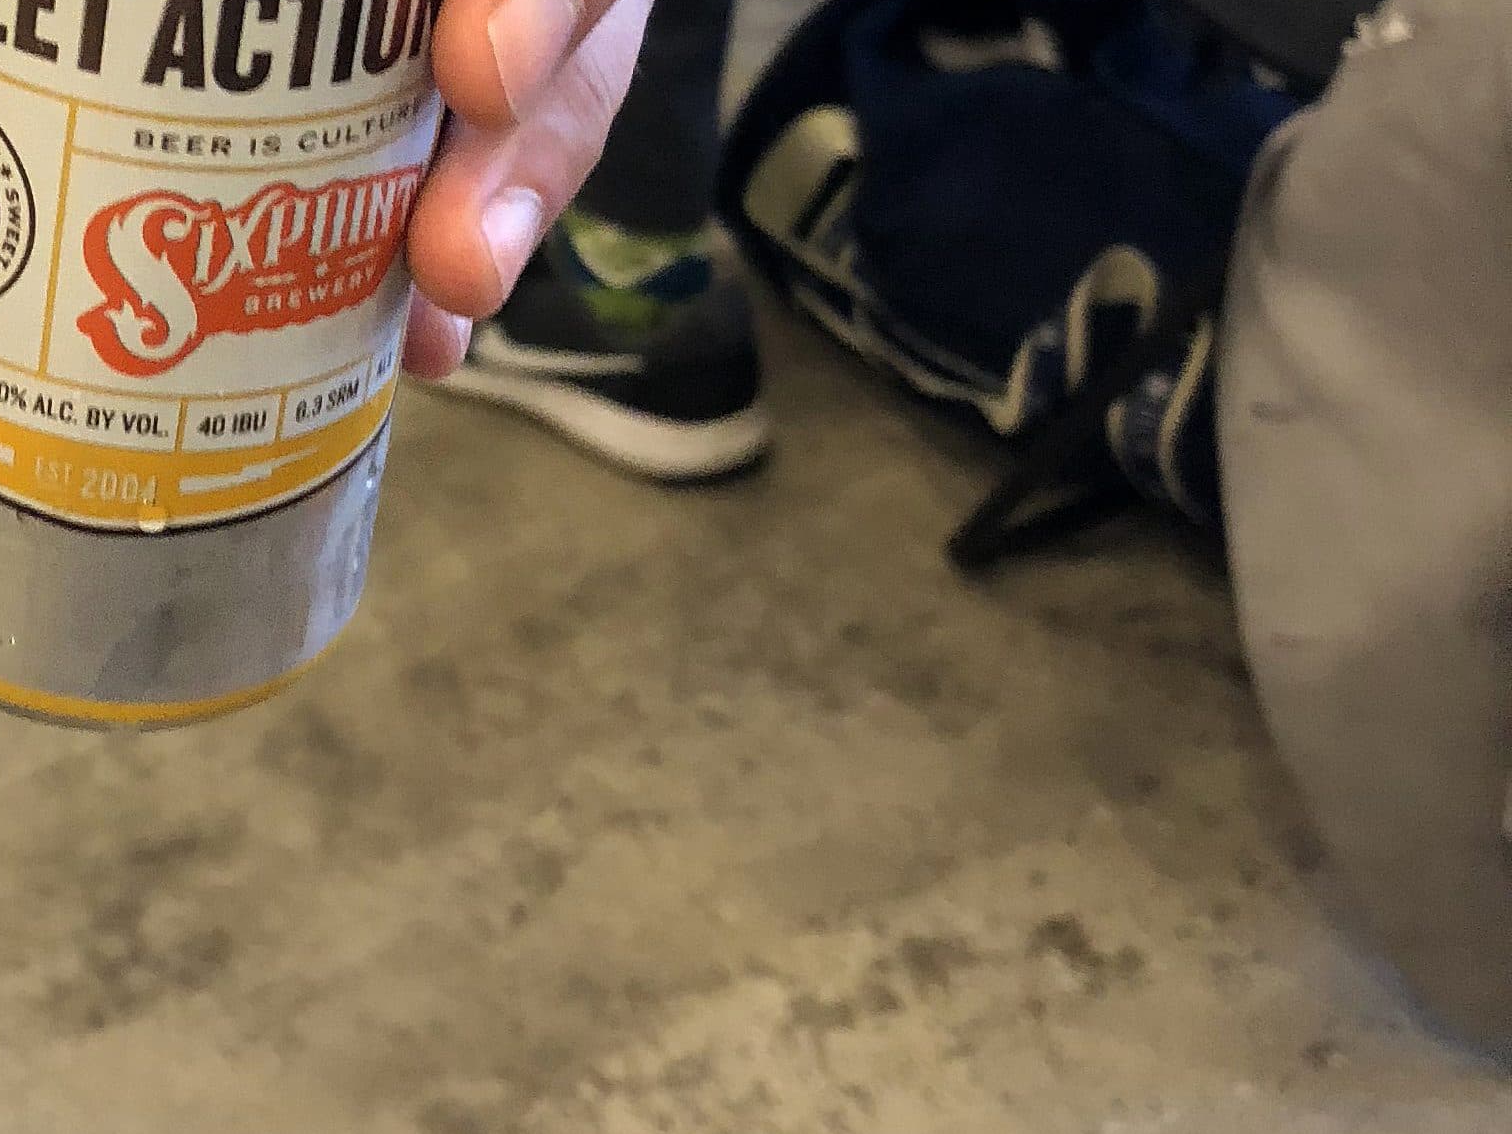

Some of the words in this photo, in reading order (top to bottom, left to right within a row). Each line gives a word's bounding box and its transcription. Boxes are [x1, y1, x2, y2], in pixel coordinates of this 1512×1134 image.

[134, 128, 233, 157] BEER
[249, 133, 283, 157] IS
[243, 262, 377, 316] BREWERY
[32, 392, 78, 426] ALC.
[86, 406, 116, 432] BY
[122, 411, 170, 438] VOL.
[197, 414, 226, 437] 40
[231, 409, 268, 433] IBU
[80, 466, 159, 506] 2004
